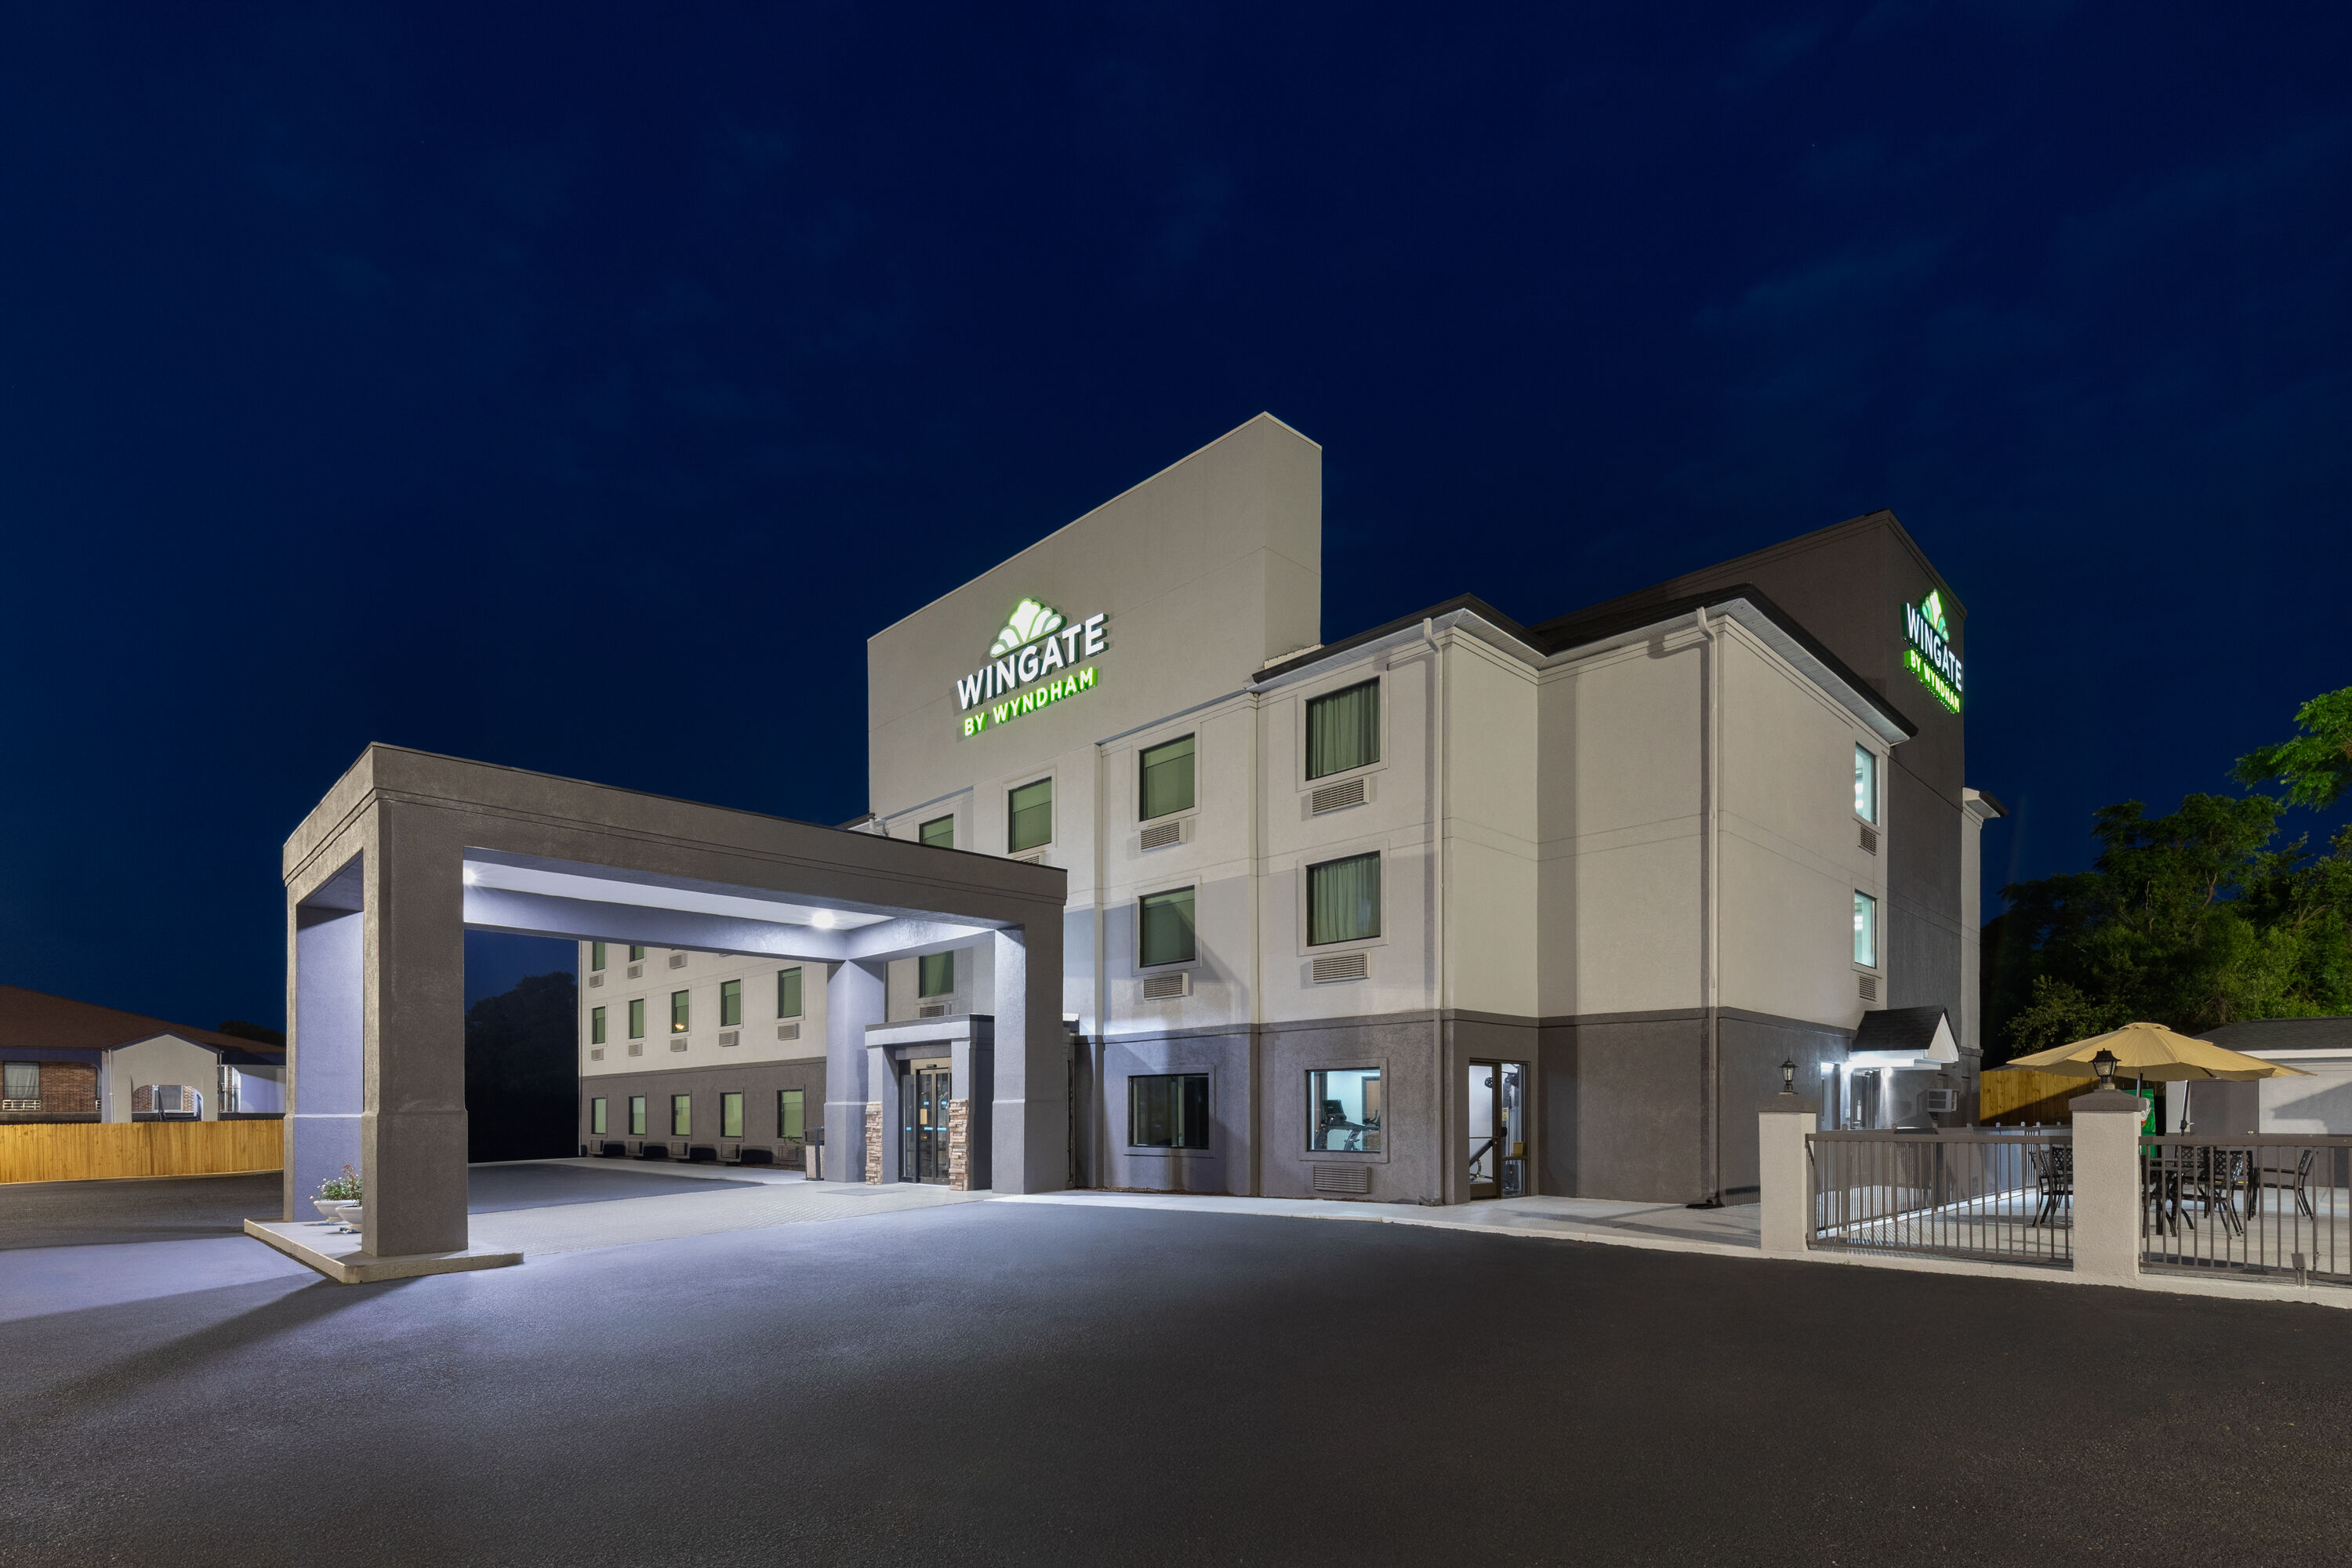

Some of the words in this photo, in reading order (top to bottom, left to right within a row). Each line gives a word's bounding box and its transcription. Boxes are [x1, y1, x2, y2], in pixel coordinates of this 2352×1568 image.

[956, 612, 1105, 710] WINGATE
[1906, 602, 1962, 692] WINGATE
[1910, 649, 1922, 672] BY
[1923, 662, 1960, 713] WYNDHAM
[964, 712, 986, 737] BY
[993, 666, 1094, 724] WYNDHAM
